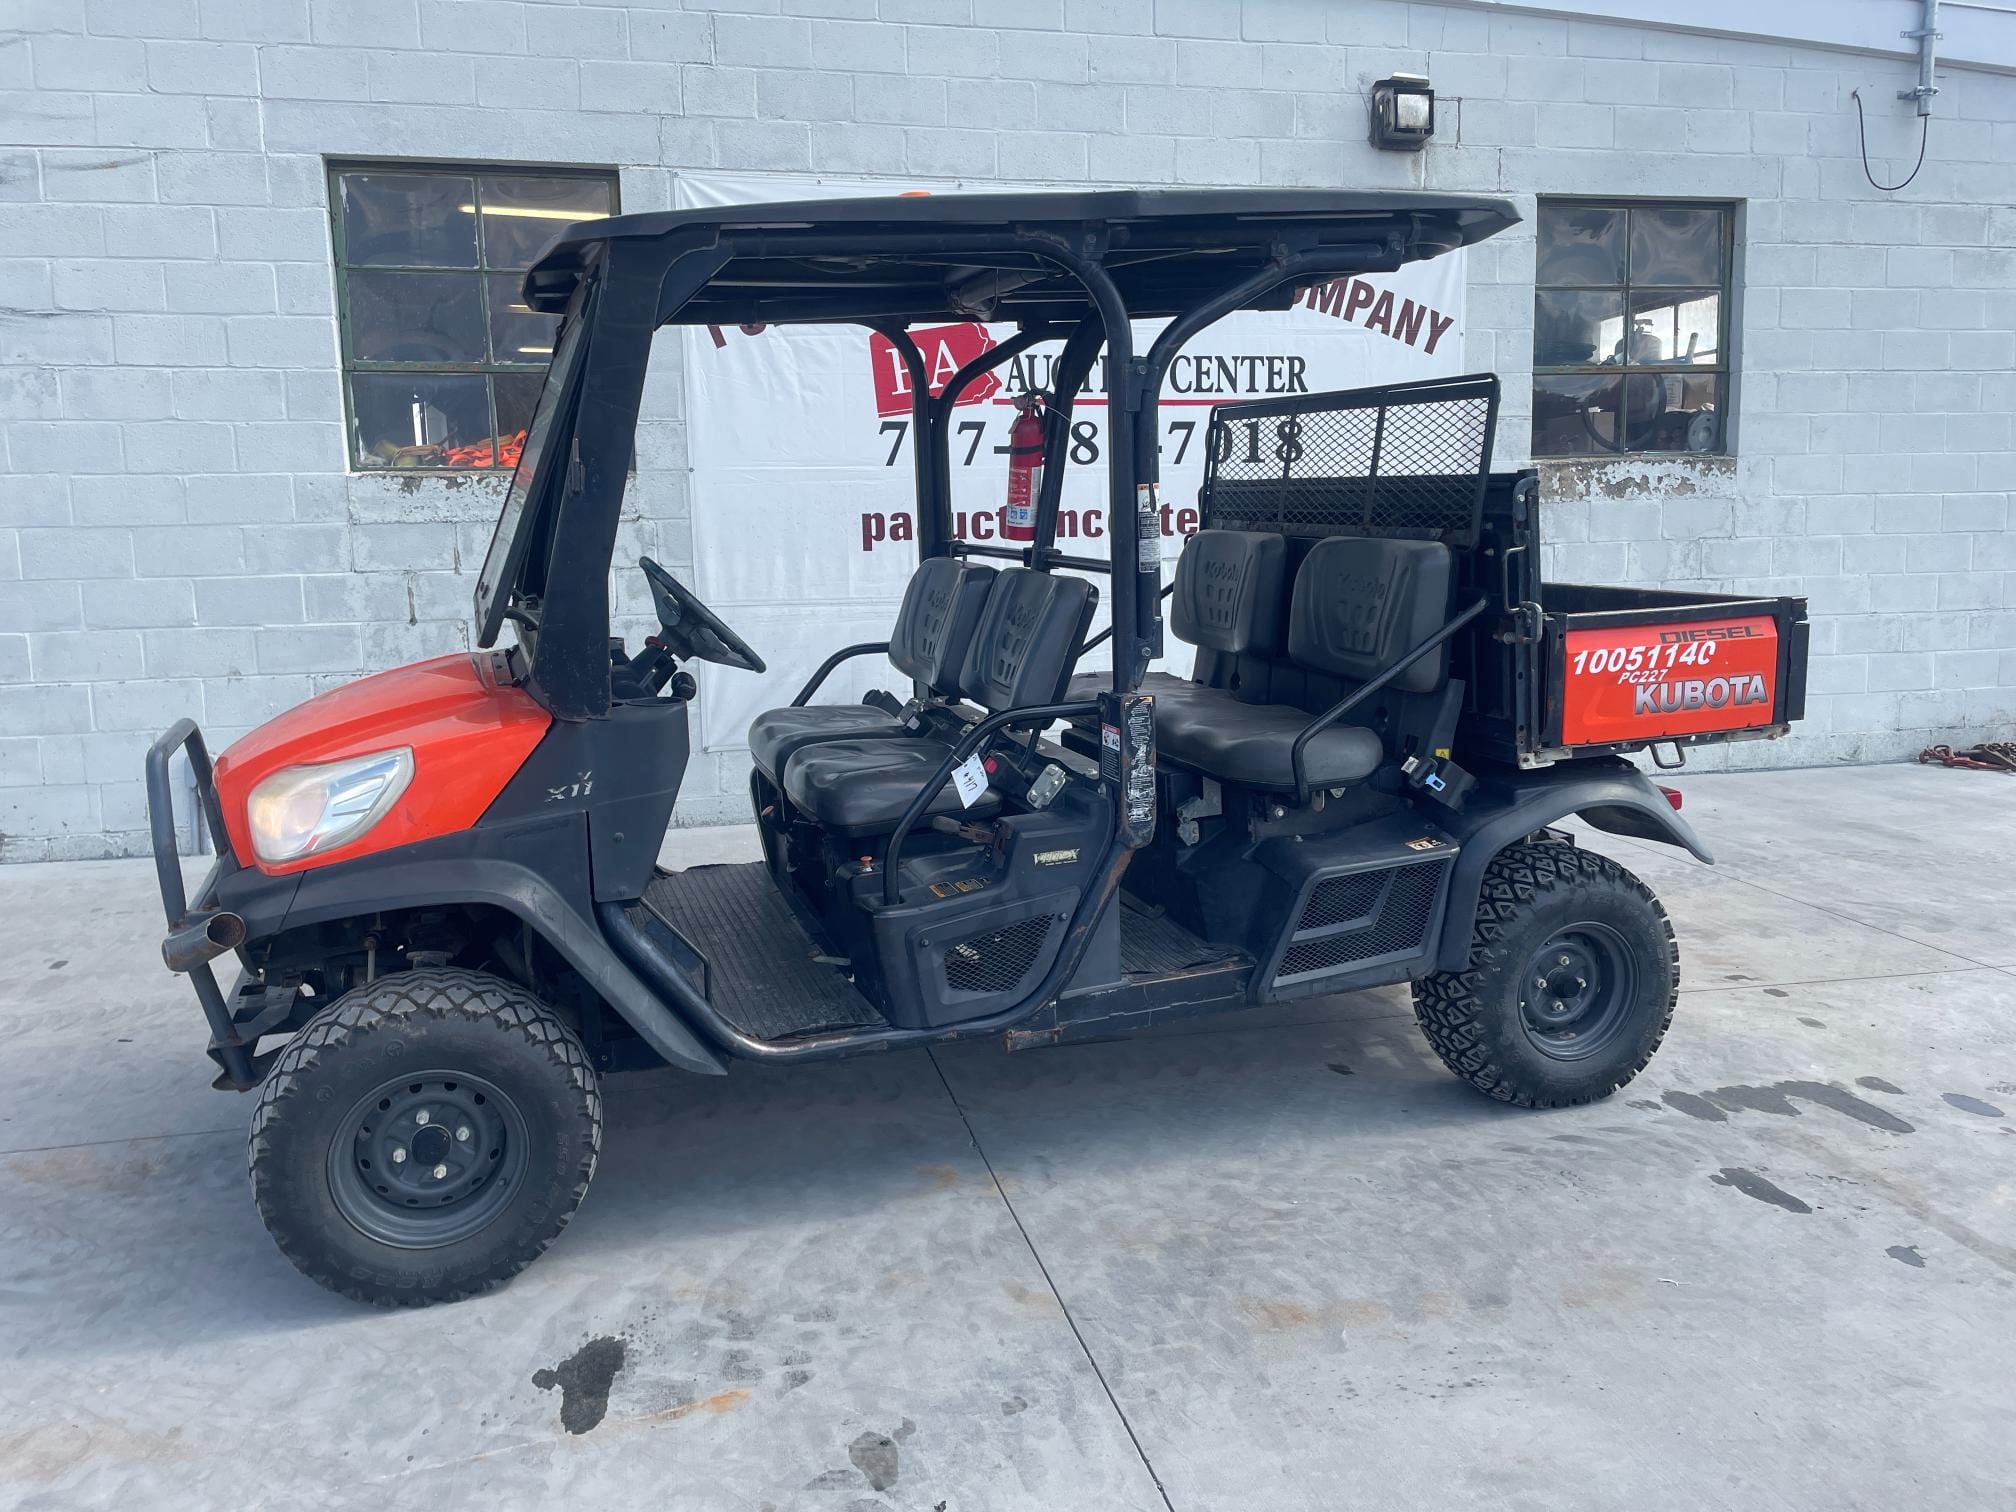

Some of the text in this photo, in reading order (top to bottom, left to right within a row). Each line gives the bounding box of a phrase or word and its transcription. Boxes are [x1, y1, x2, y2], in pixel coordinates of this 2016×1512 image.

[1169, 354, 1309, 394] CENTER
[1660, 625, 1765, 644] DIESEL
[1617, 668, 1669, 685] PC227
[1634, 673, 1769, 715] KUBOTA
